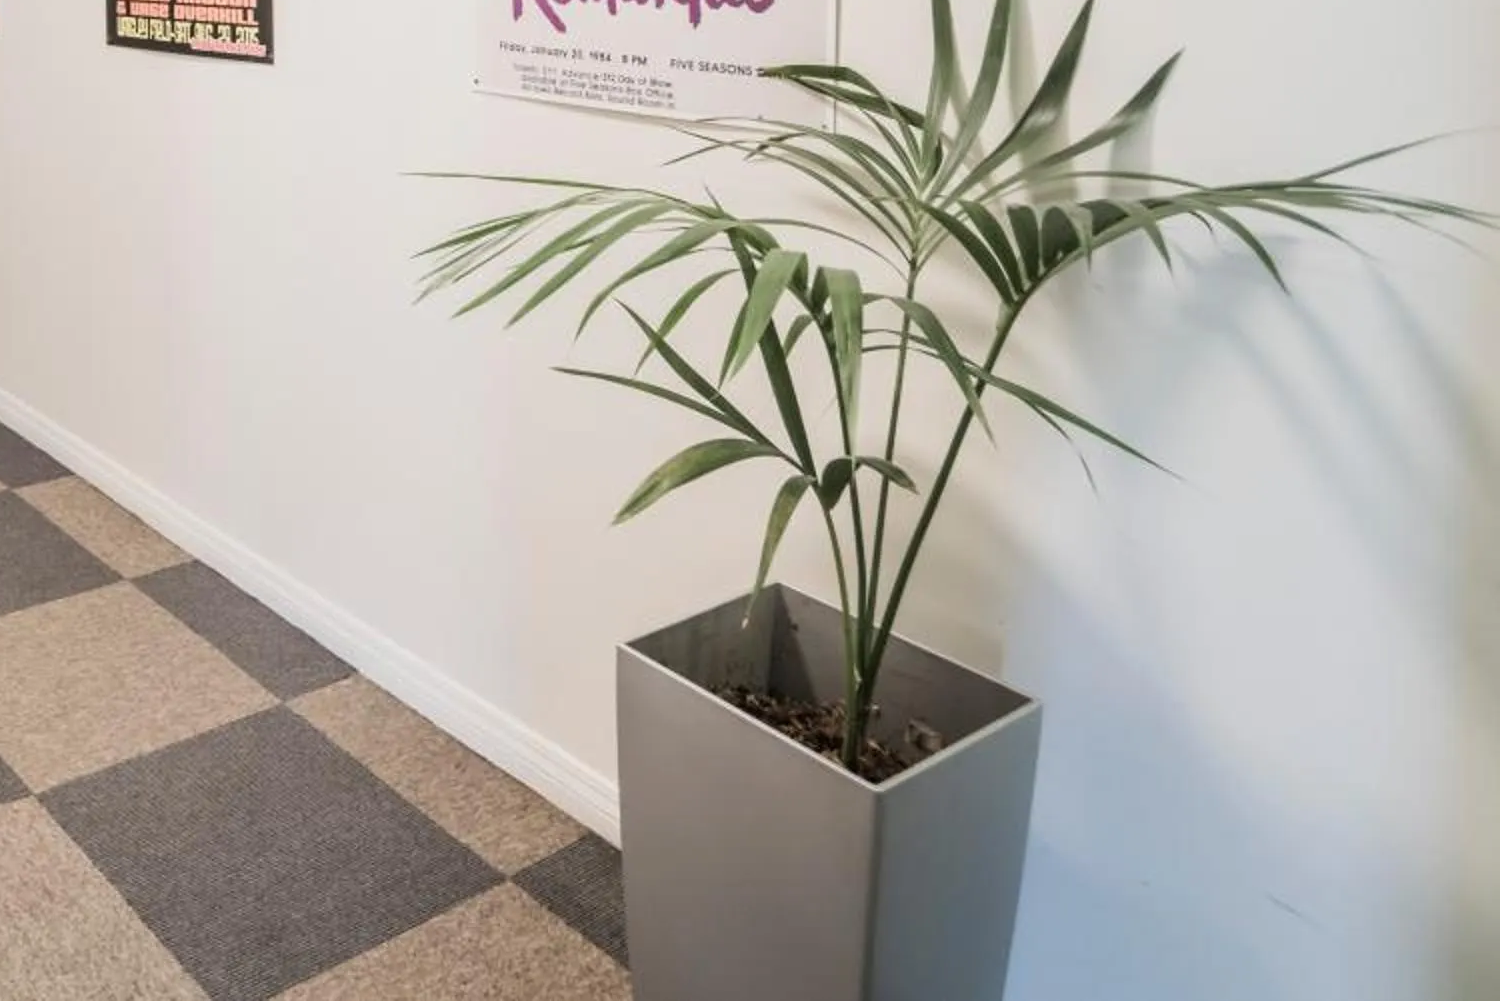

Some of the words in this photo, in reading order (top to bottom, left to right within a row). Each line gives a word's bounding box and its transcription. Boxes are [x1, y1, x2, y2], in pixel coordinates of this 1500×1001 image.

[632, 55, 649, 67] PM
[670, 58, 694, 72] FIVE
[698, 61, 753, 77] SEASONS
